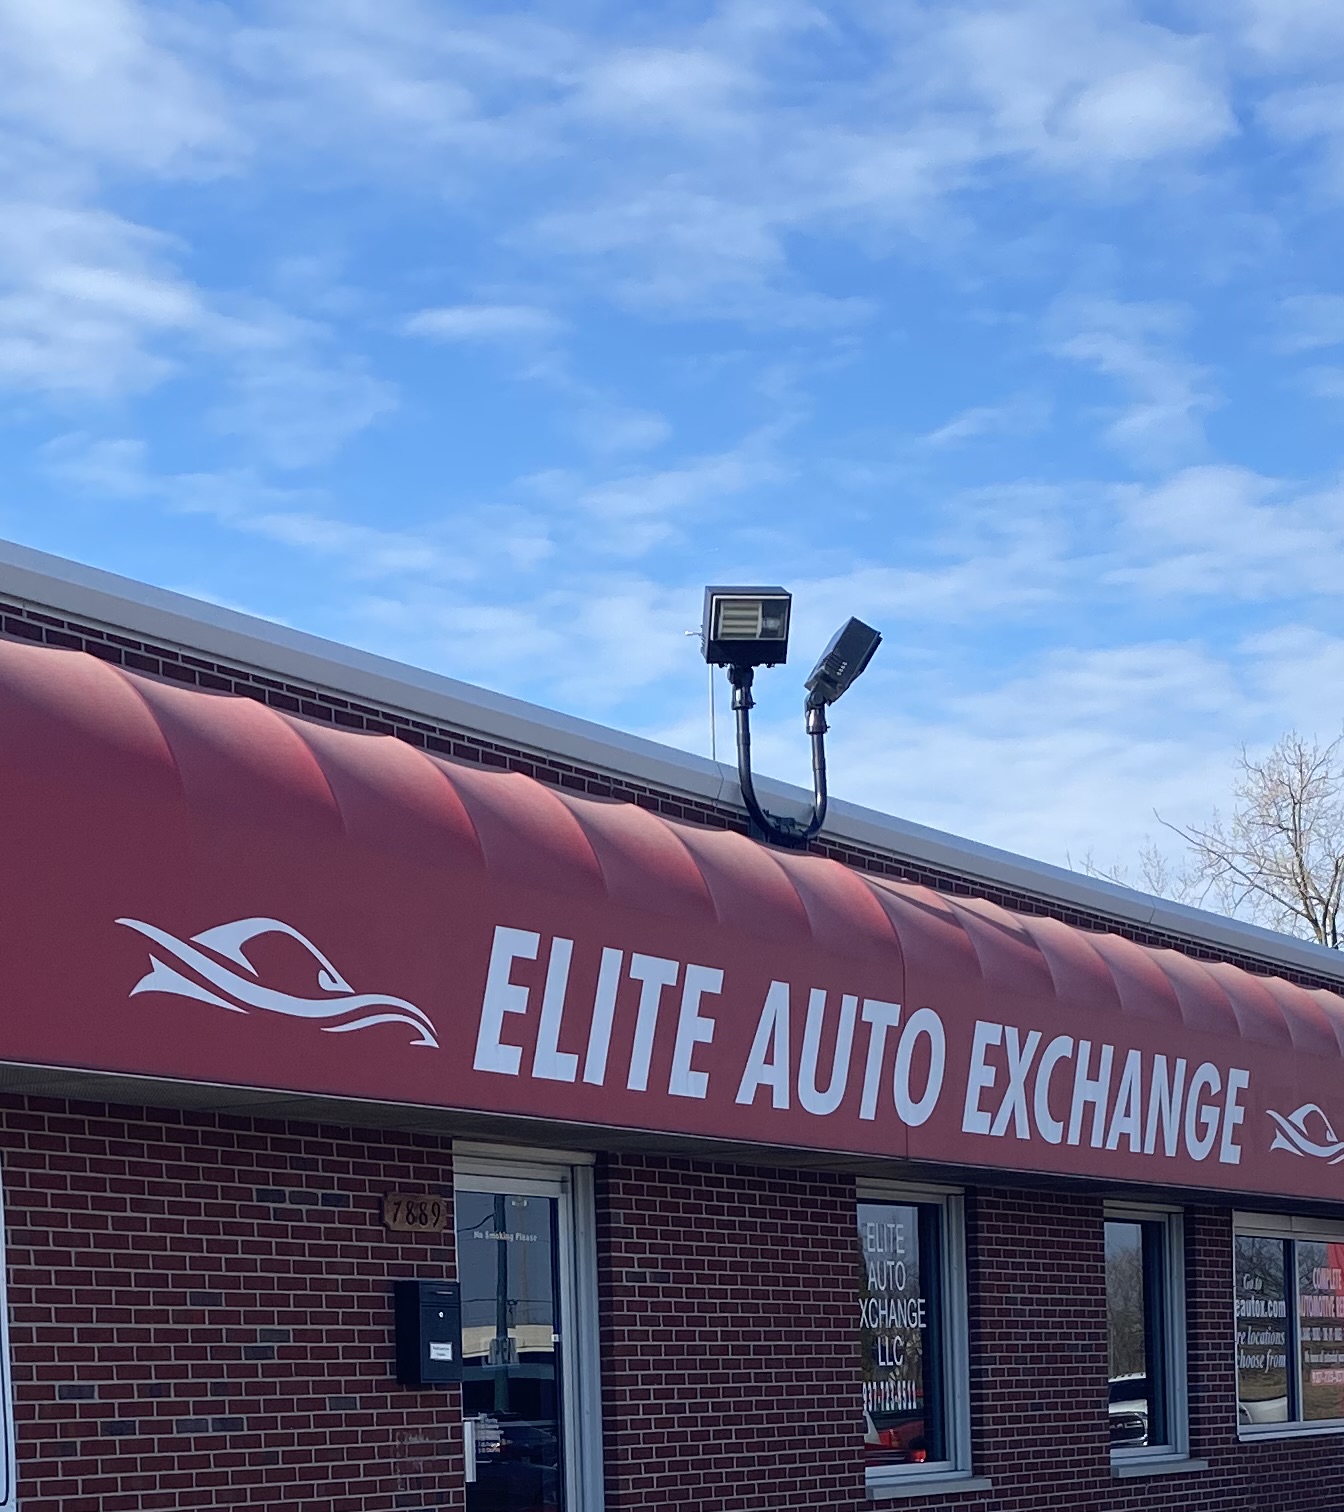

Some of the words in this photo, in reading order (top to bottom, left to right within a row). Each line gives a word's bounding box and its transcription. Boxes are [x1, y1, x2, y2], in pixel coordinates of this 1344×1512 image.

[472, 925, 725, 1100] ELITE
[735, 980, 946, 1127] AUTO
[962, 1020, 1251, 1165] EXCHANGE
[392, 1200, 441, 1229] 7889
[473, 1230, 484, 1239] No
[485, 1230, 515, 1242] Smoking
[516, 1232, 538, 1242] Please
[866, 1222, 906, 1254] ELITE
[867, 1261, 907, 1291] AUTO
[1247, 1326, 1286, 1346] locations
[878, 1336, 904, 1366] LLC
[1265, 1348, 1287, 1374] from
